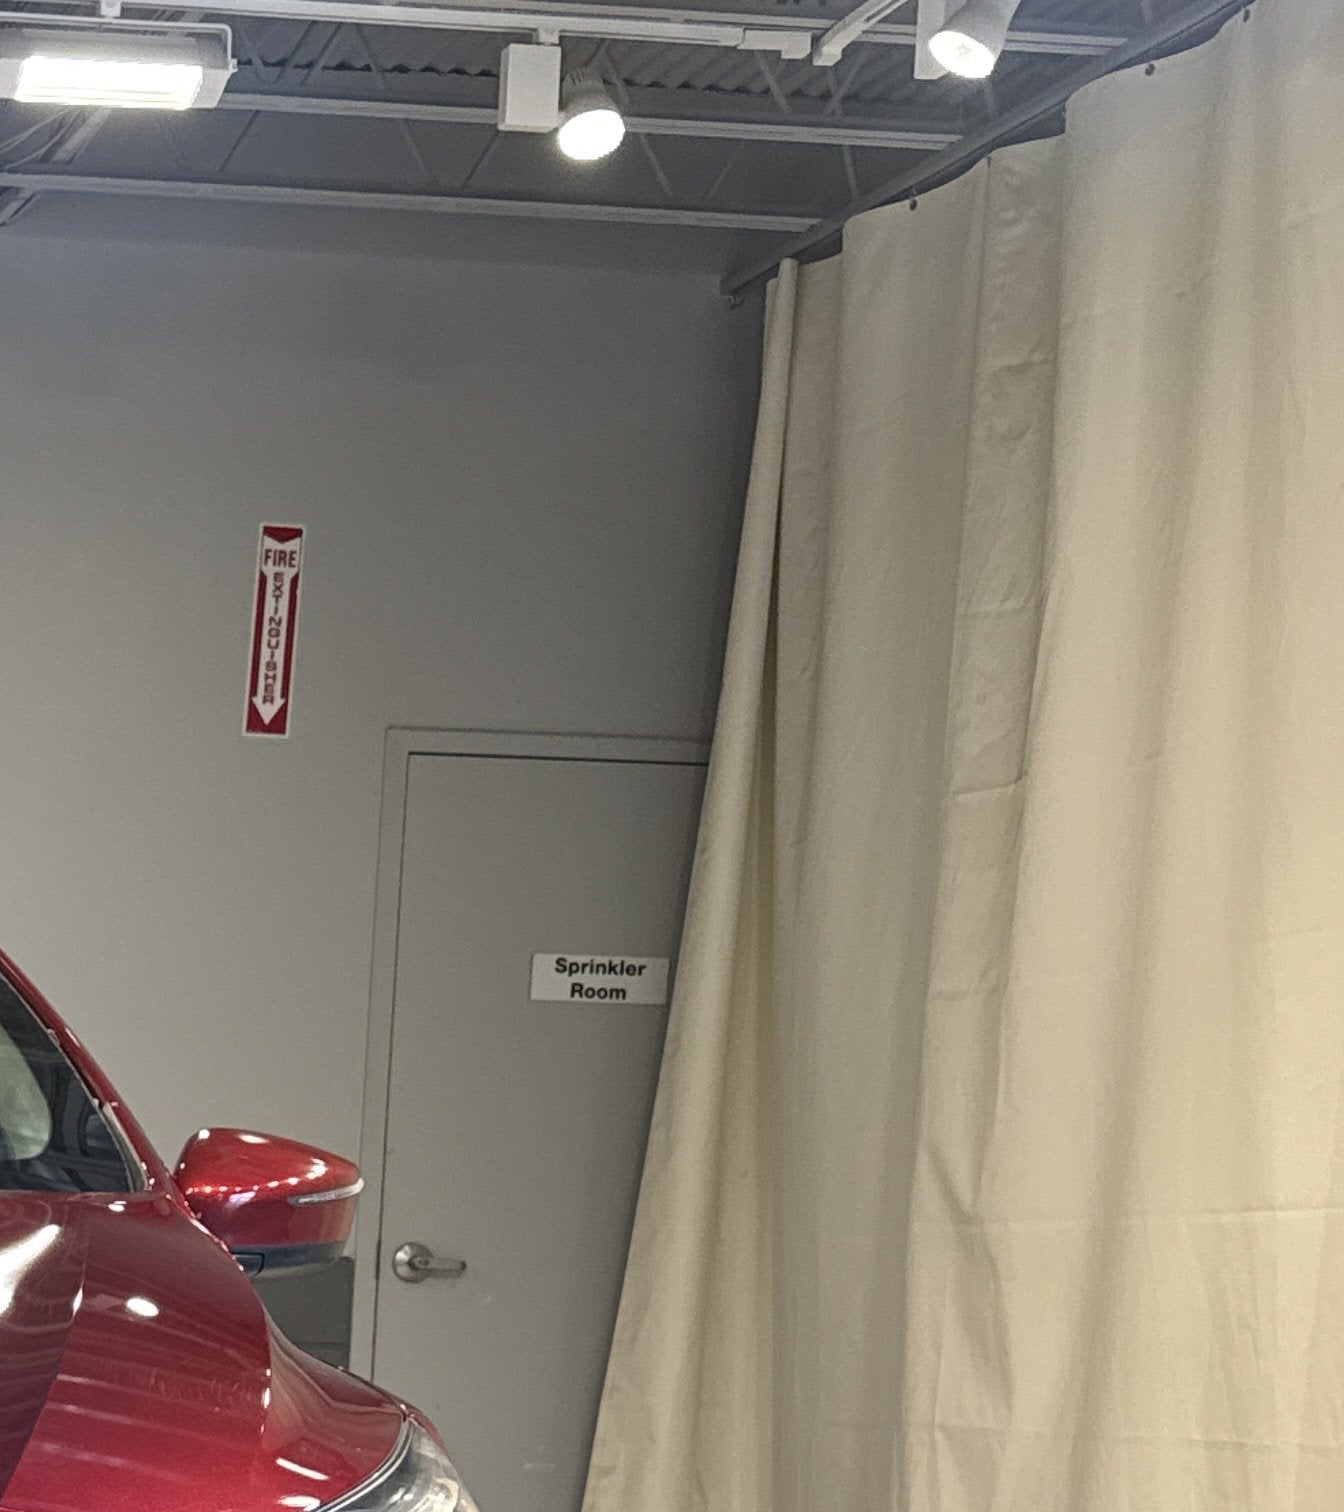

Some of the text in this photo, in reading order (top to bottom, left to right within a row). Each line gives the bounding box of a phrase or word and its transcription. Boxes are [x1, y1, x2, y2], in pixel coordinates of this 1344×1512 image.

[263, 548, 297, 568] FIRE
[262, 572, 285, 705] EXTINGUISHER
[554, 957, 647, 977] Sprinkler
[570, 982, 626, 1000] Room
